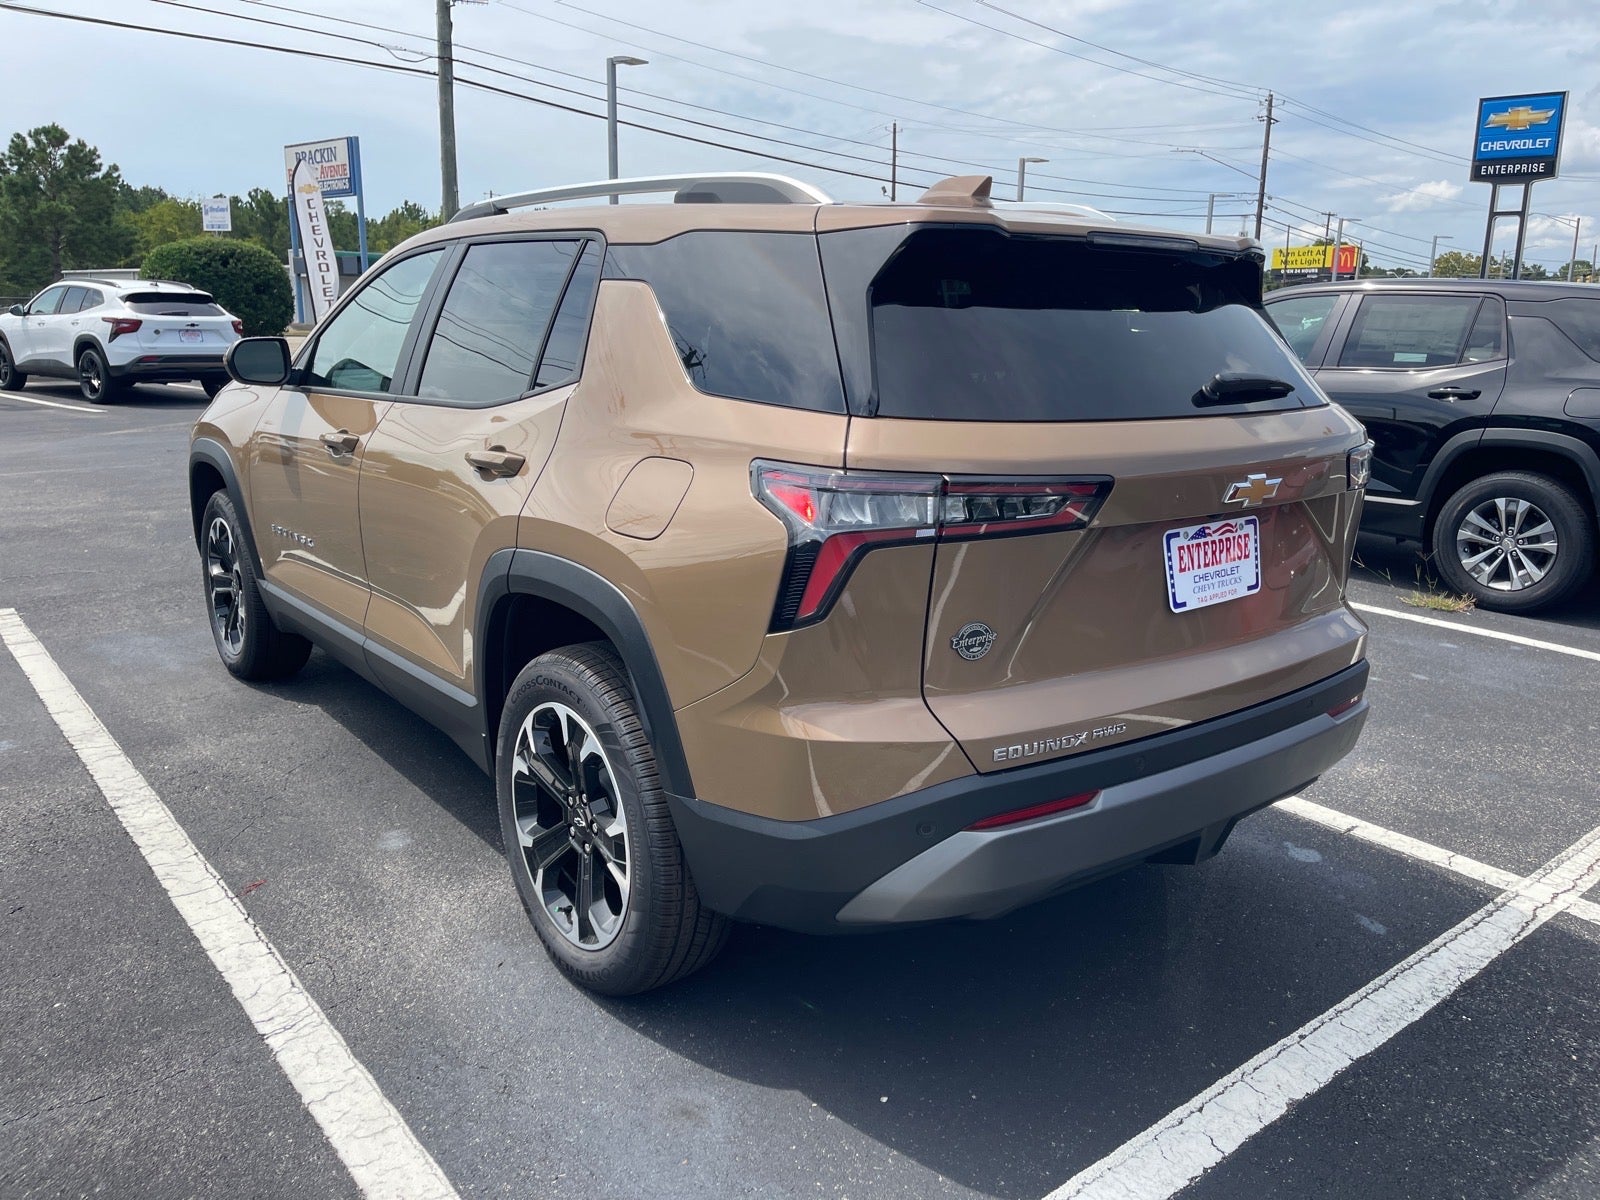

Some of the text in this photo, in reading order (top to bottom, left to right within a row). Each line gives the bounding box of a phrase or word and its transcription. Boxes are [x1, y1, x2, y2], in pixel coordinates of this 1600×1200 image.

[1480, 138, 1552, 152] CHEVROLET
[1481, 163, 1546, 175] ENTERPRISE
[306, 198, 335, 310] CHEVROLET
[1300, 257, 1321, 267] Light
[1177, 533, 1251, 574] ENTERPRISE
[1193, 566, 1240, 583] CHEVROLET
[1193, 576, 1242, 594] CHEVY TRUCKS
[1209, 591, 1227, 602] APPLIED
[1228, 588, 1238, 597] FOR
[951, 631, 998, 649] Enterprise
[993, 722, 1127, 762] EQUINOX AWD
